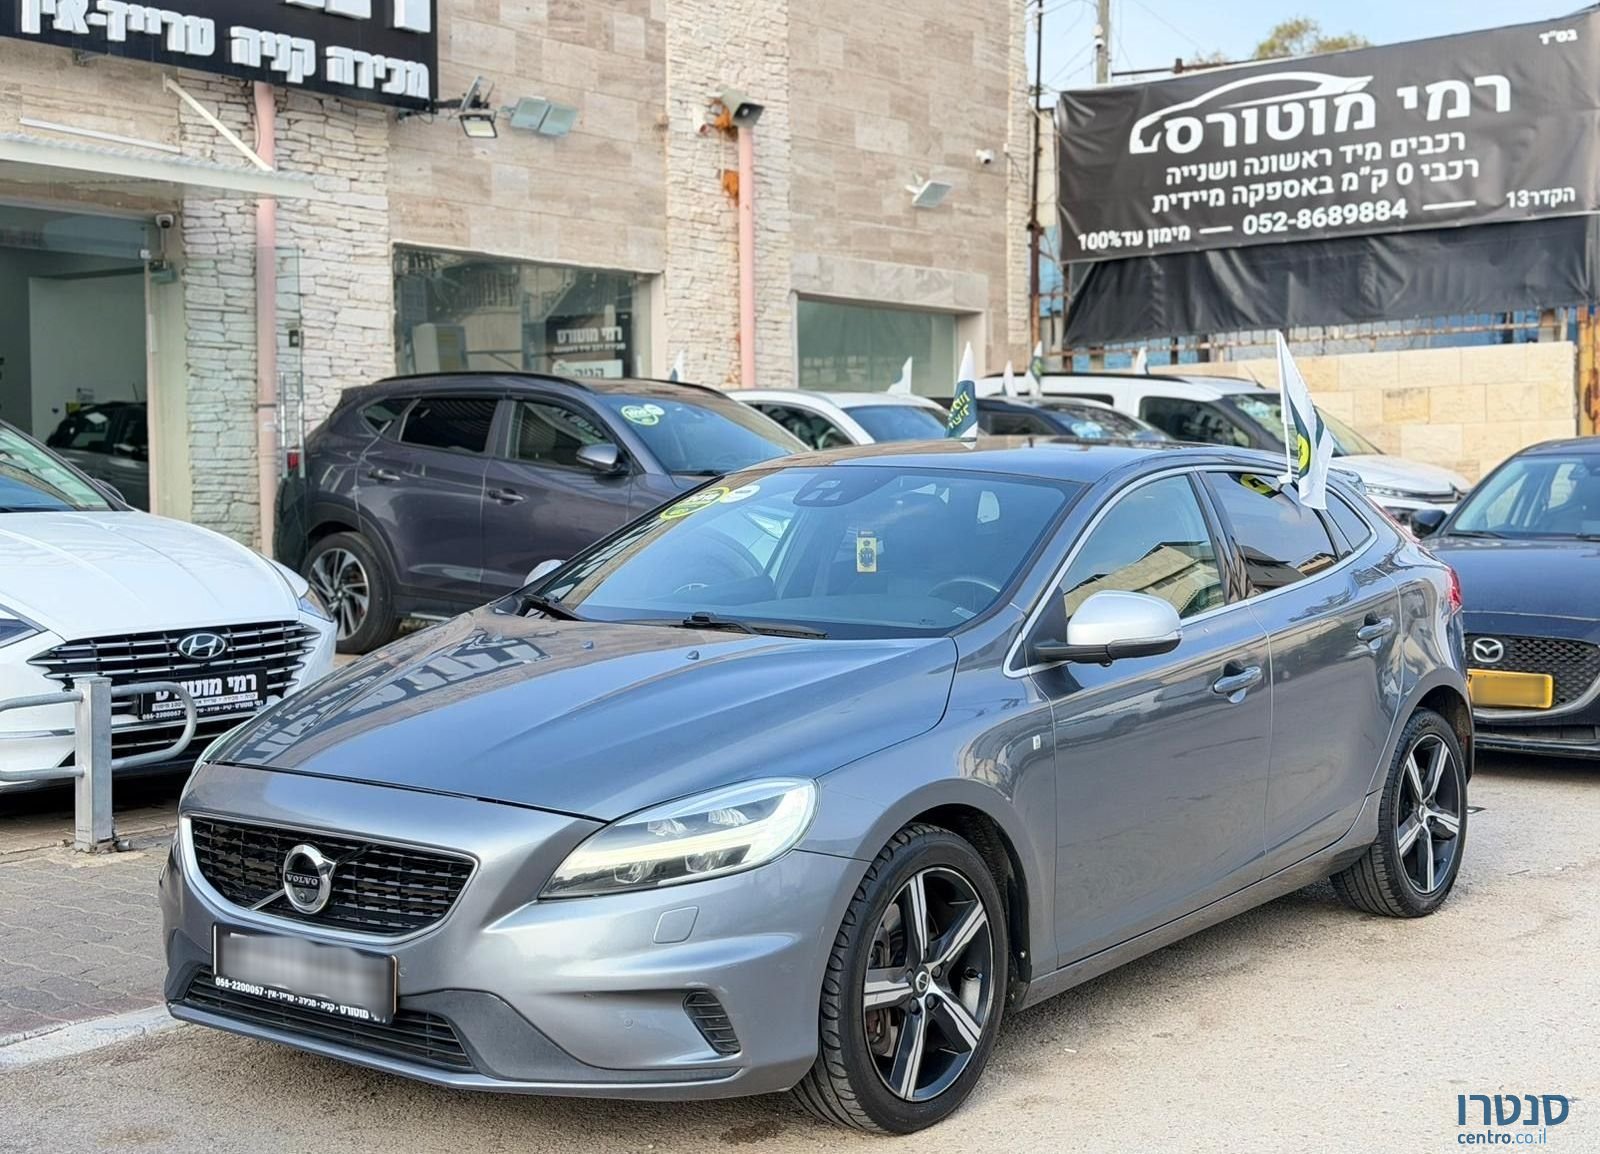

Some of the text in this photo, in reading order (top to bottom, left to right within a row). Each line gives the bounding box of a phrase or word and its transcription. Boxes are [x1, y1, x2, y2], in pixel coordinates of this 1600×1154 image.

[1539, 28, 1578, 45] בס"ד
[230, 26, 316, 84] קניה
[326, 45, 430, 99] מכירה
[1163, 74, 1511, 154] רמי מוטורס
[1166, 131, 1466, 186] רכבים מיד ראשונה ושנייה
[1152, 158, 1480, 214] רכבי 0 ק"מ באספקה מיידית
[1242, 198, 1408, 235] 052-8689884
[1147, 224, 1191, 248] מימון
[227, 674, 257, 693] רמי
[286, 873, 318, 886] VOLVO
[298, 996, 317, 1008] מכירה
[320, 1001, 336, 1013] קניה
[339, 1005, 370, 1019] מוטורס
